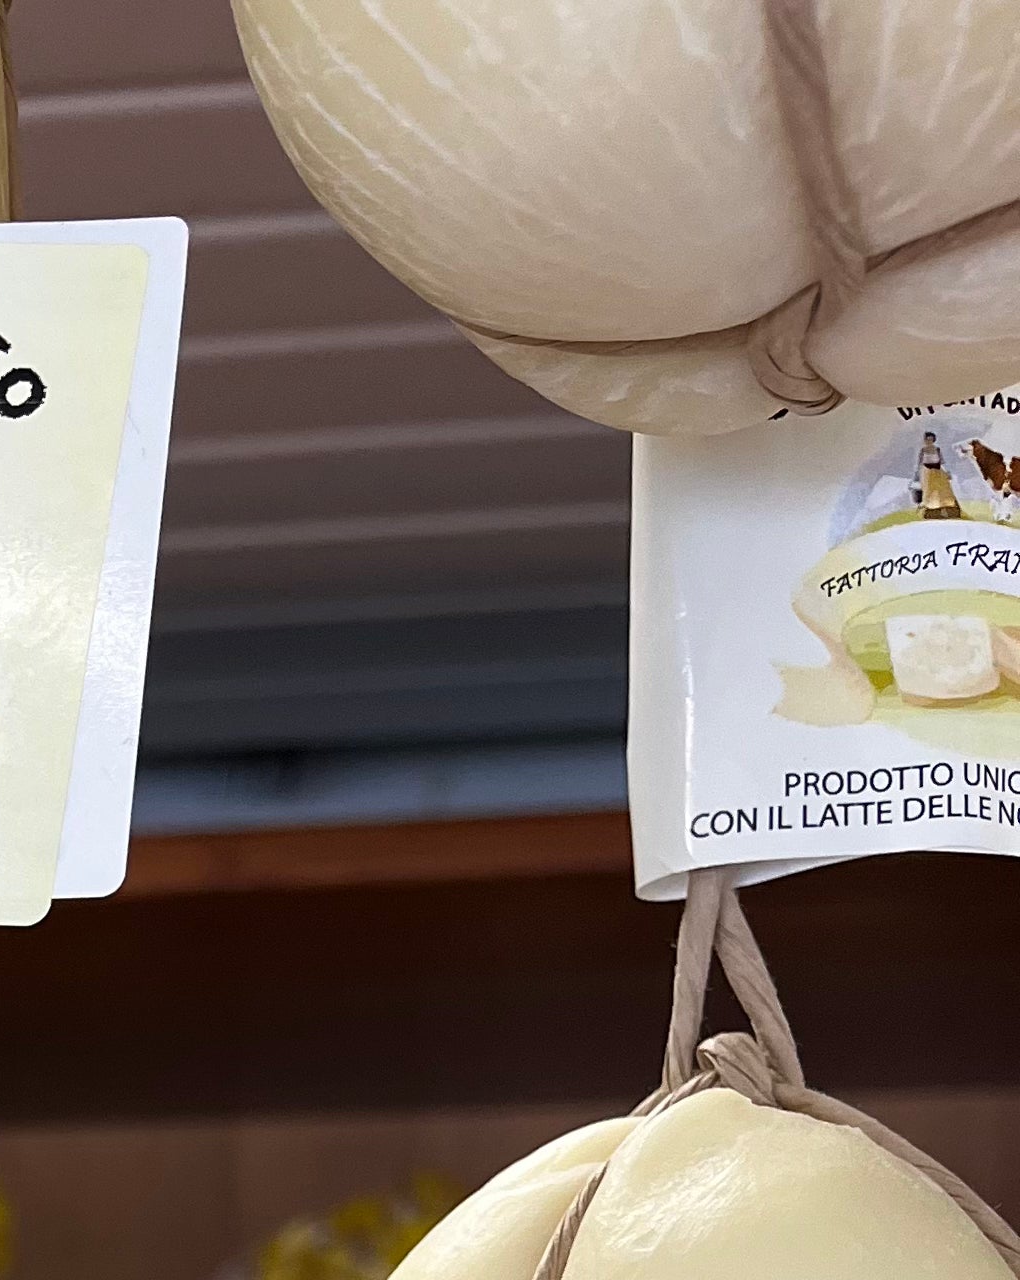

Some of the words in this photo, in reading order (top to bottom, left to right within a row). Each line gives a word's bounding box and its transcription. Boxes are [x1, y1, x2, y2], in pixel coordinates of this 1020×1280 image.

[784, 762, 954, 797] PRODOTTO
[690, 807, 758, 838] CON
[768, 805, 792, 830] IL
[802, 800, 893, 829] LATTE
[903, 793, 992, 823] DELLE
